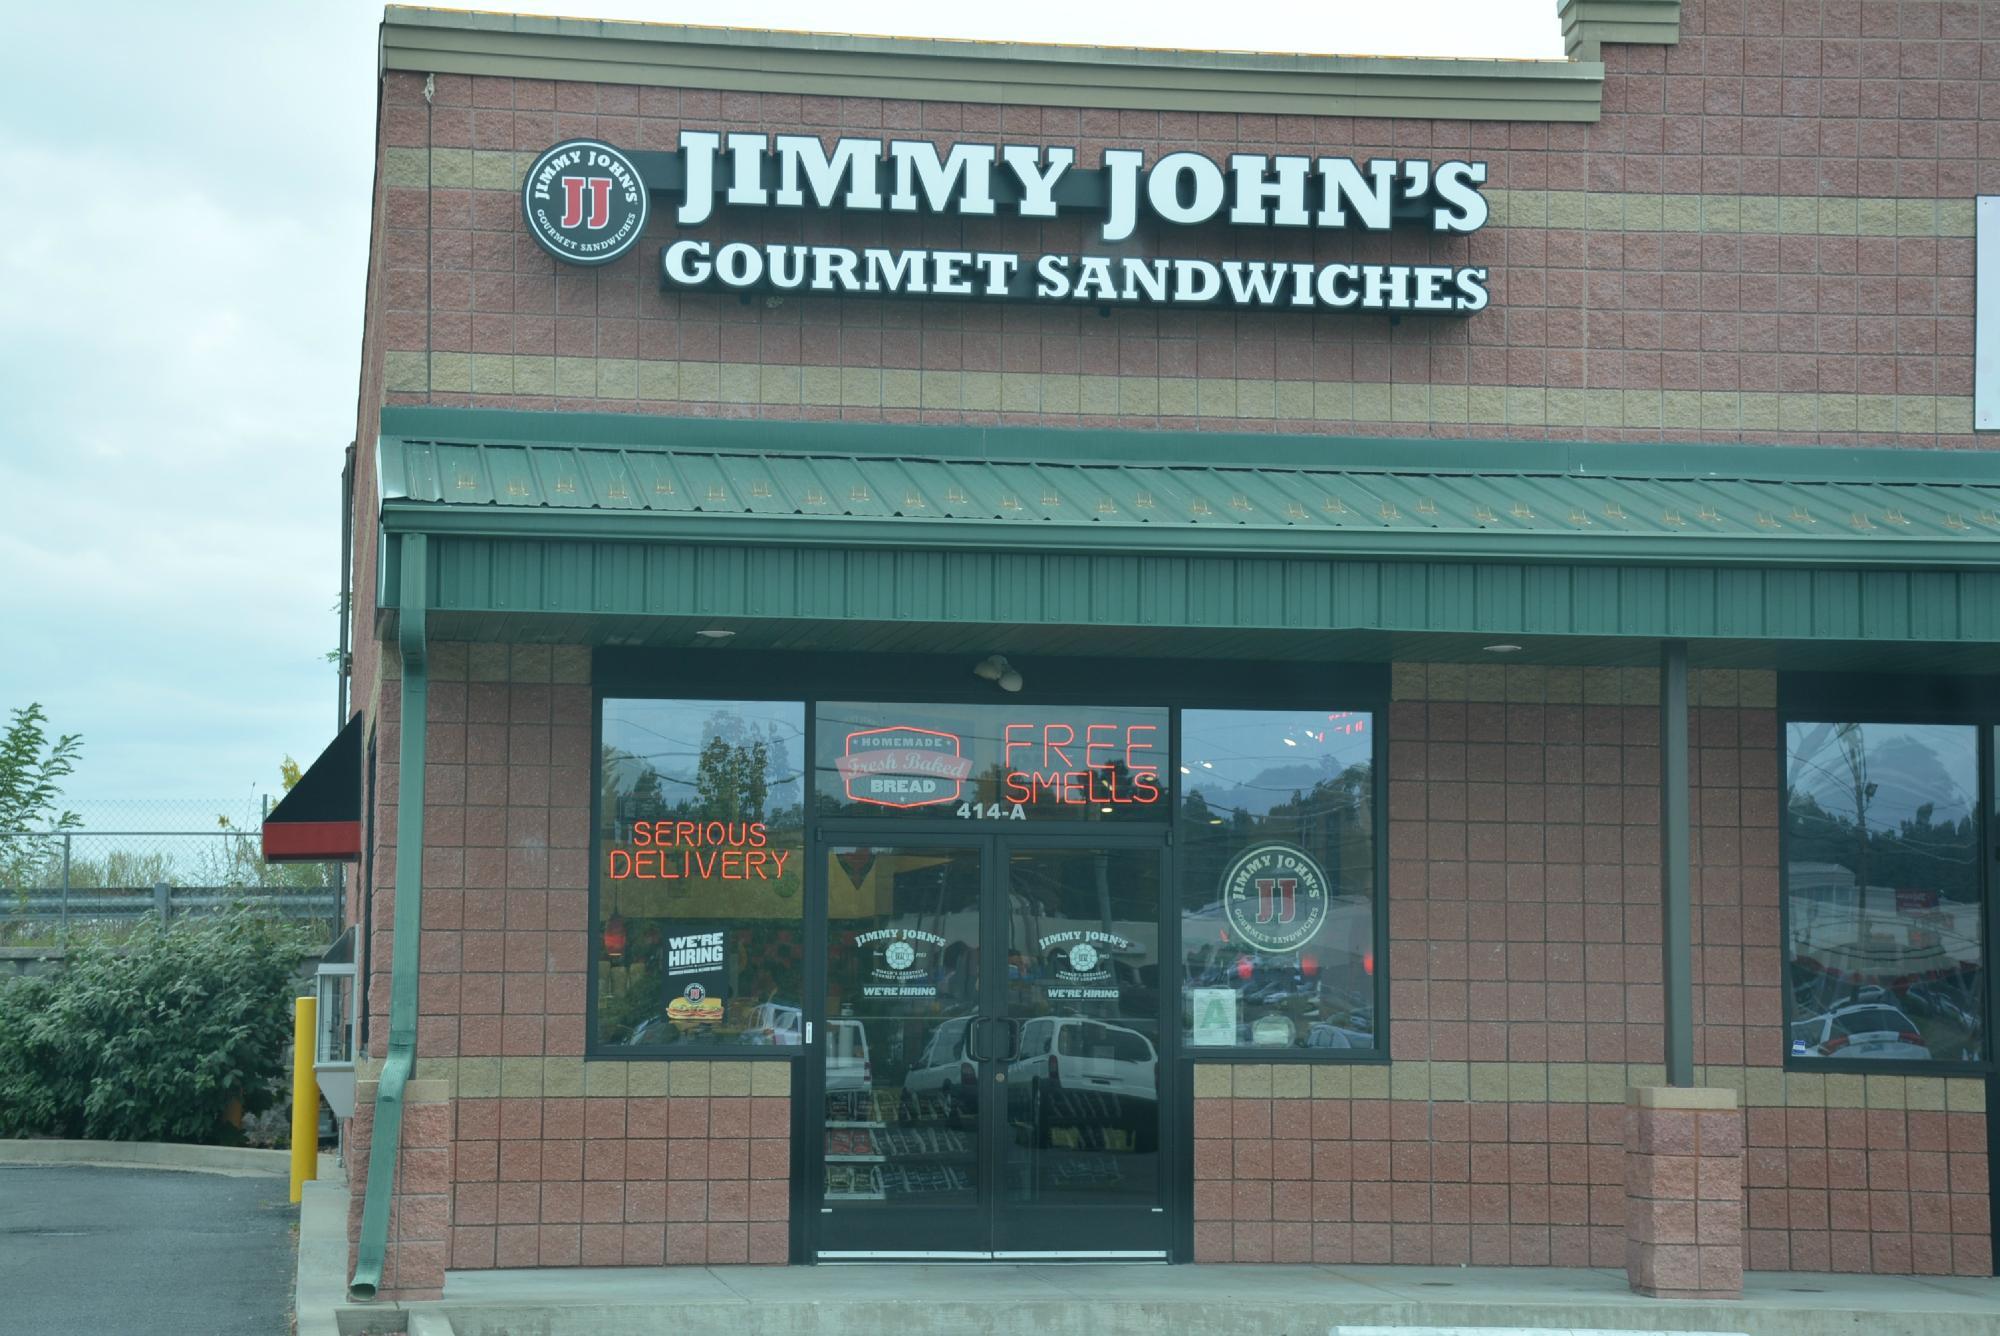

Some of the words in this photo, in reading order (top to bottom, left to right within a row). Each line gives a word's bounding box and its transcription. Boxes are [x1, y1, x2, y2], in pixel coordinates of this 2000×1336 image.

[535, 151, 581, 200] JIMMY
[588, 151, 638, 204] JOHN'S
[678, 131, 1074, 226] JIMMY
[1102, 147, 1490, 241] JOHN'S
[561, 177, 612, 229] JJ
[537, 209, 578, 249] GOURMET
[580, 212, 636, 252] SANDWICHES
[665, 241, 1020, 297] GOURMET
[1036, 252, 1490, 312] SANDWICHES
[861, 737, 943, 748] HOMEMADE
[1005, 724, 1157, 769] FREE
[848, 753, 897, 777] Fresh
[903, 751, 965, 777] Baked
[870, 779, 936, 794] BREAD
[1005, 772, 1158, 804] SMELLS
[957, 802, 1027, 821] 414-A
[633, 821, 767, 848] SERIOUS
[609, 849, 789, 880] DELIVERY
[1233, 855, 1271, 900] JIMMY
[1276, 854, 1320, 899] JOHN'S
[1255, 877, 1297, 924] JJ
[669, 932, 724, 950] WE'RE
[854, 928, 899, 948] JIMMY
[902, 929, 947, 948] JOHN'S
[1038, 931, 1082, 950] JIMMY
[1085, 931, 1129, 949] JOHN'S
[1235, 908, 1270, 942] GOURMET
[1273, 907, 1319, 944] SANDWICHES
[668, 946, 724, 967] HIRING
[863, 986, 898, 996] WE'RE
[899, 987, 936, 996] HIRING
[1047, 988, 1082, 998] WE'RE
[1083, 989, 1120, 998] HIRING
[1199, 998, 1232, 1029] A
